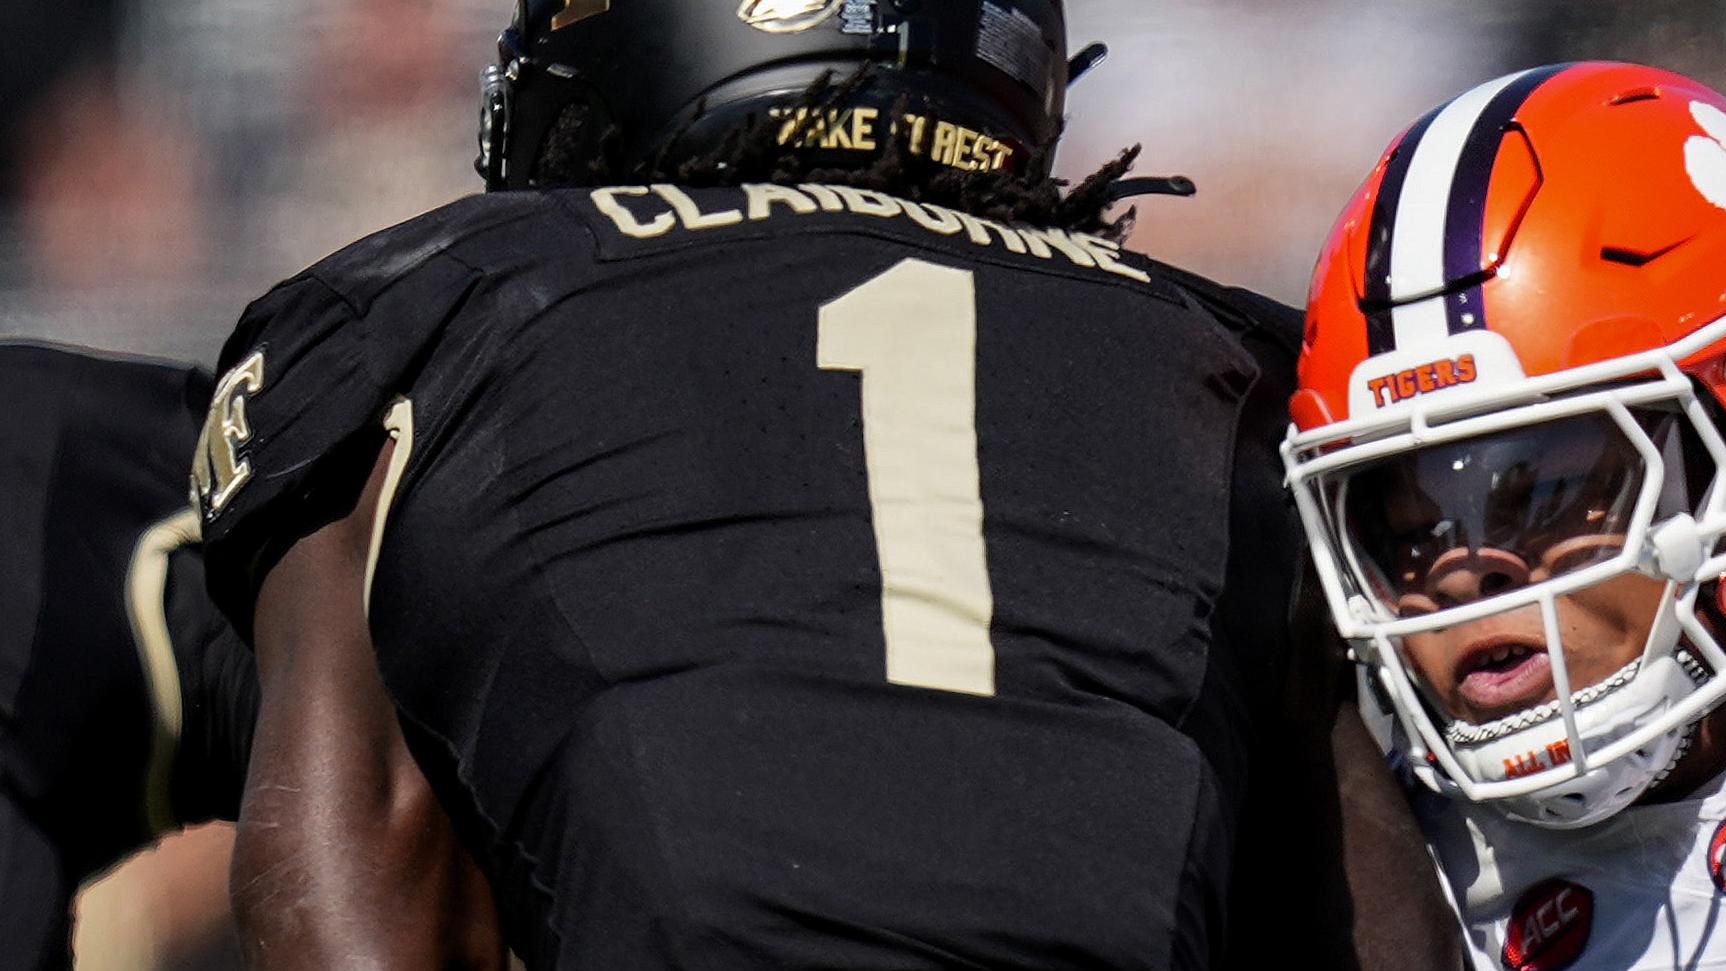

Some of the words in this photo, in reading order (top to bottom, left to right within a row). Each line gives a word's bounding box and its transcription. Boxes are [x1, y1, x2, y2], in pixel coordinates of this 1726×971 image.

[890, 113, 1013, 173] REST
[1367, 352, 1478, 409] TIGERS
[816, 257, 996, 697] 1
[1503, 750, 1546, 780] ALL
[1519, 886, 1580, 956] ACC
